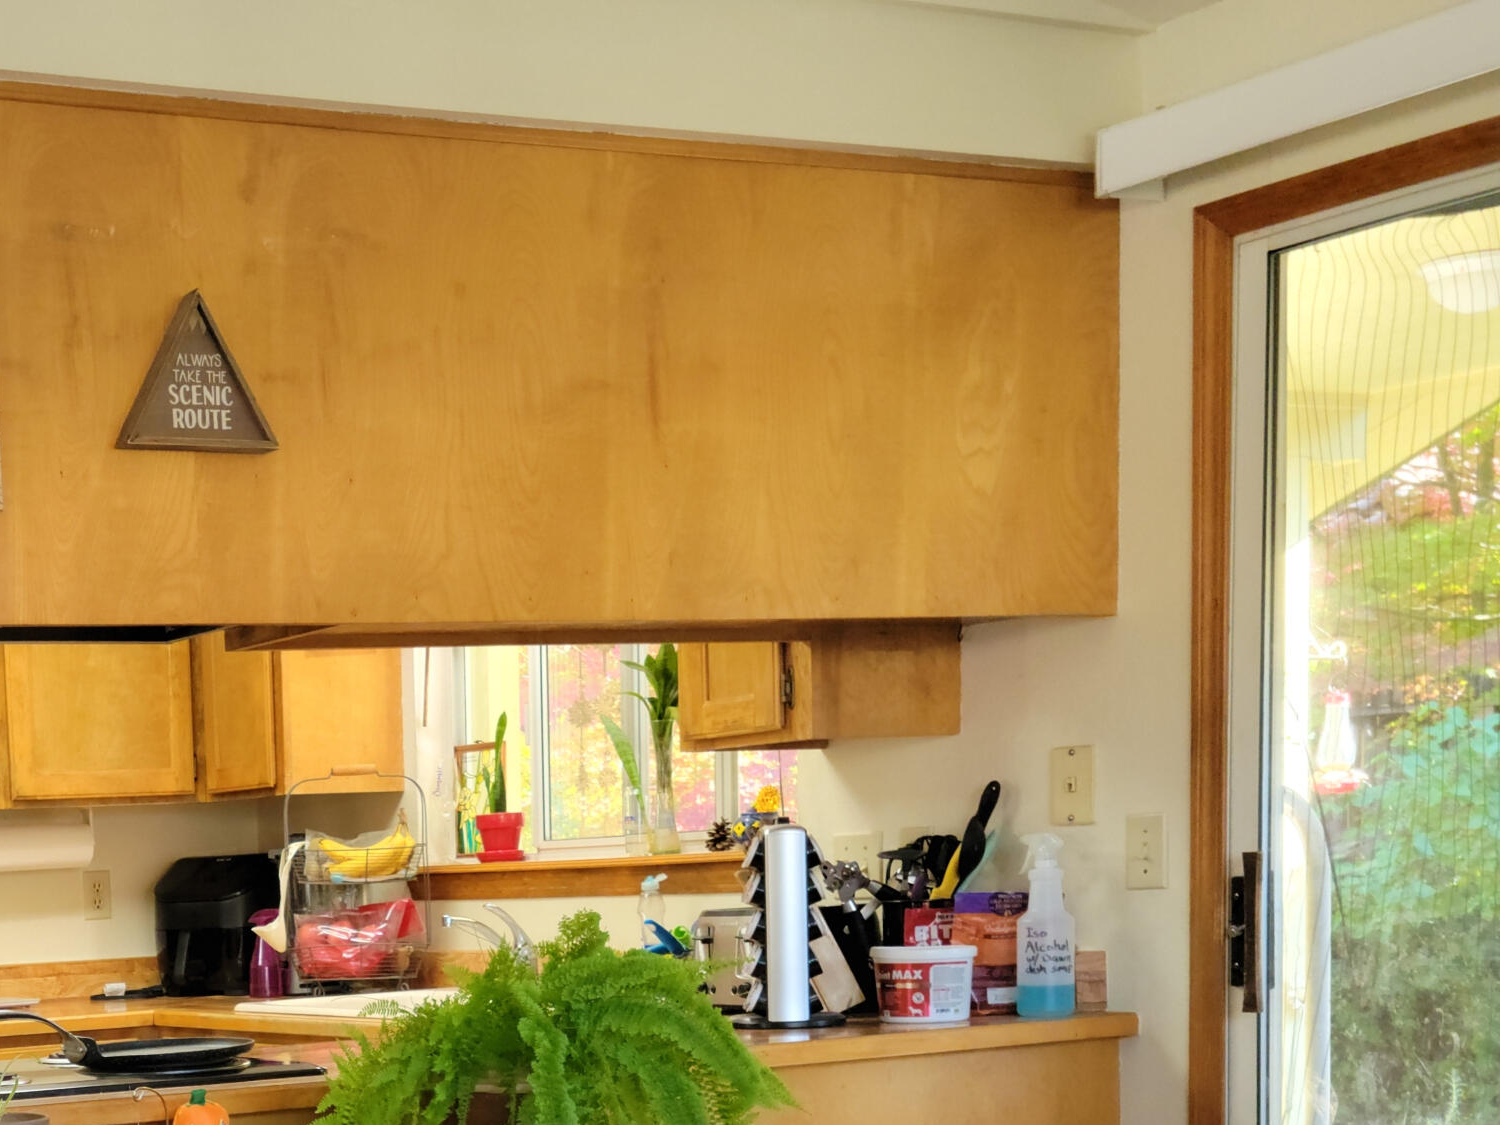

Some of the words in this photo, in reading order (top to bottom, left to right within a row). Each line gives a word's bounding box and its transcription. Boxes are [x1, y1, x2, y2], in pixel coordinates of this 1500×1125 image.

[175, 352, 222, 368] ALWAYS
[172, 368, 202, 383] TAKE
[206, 370, 227, 384] THE
[168, 384, 234, 406] SCENIC
[172, 408, 232, 430] ROUTE
[915, 924, 955, 942] BIT
[1025, 936, 1069, 954] Alcohol
[892, 969, 923, 980] MAX
